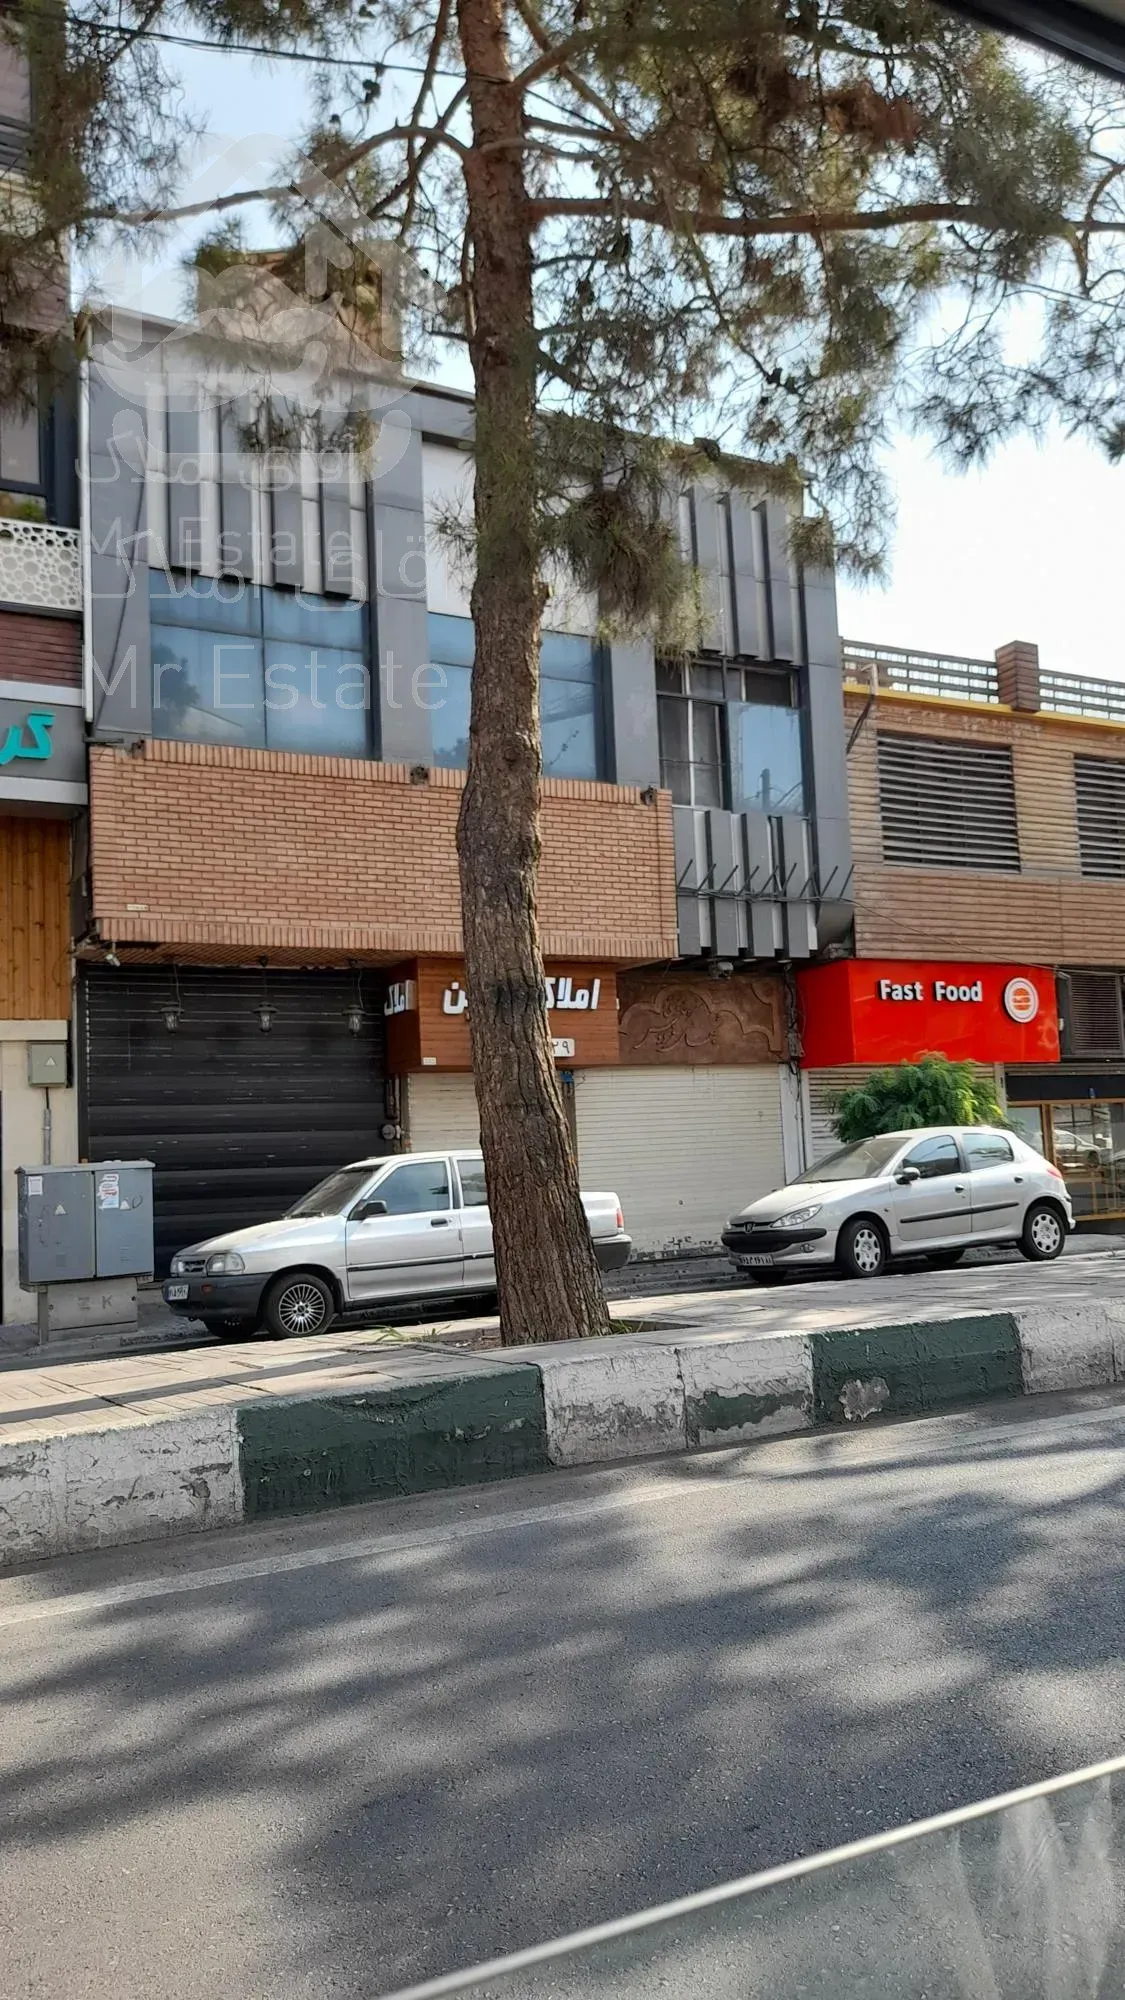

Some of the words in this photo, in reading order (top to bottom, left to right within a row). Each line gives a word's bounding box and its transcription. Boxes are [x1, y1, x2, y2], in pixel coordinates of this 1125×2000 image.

[384, 979, 417, 1016] املاک
[880, 979, 924, 1001] Fast
[935, 980, 983, 1002] Food
